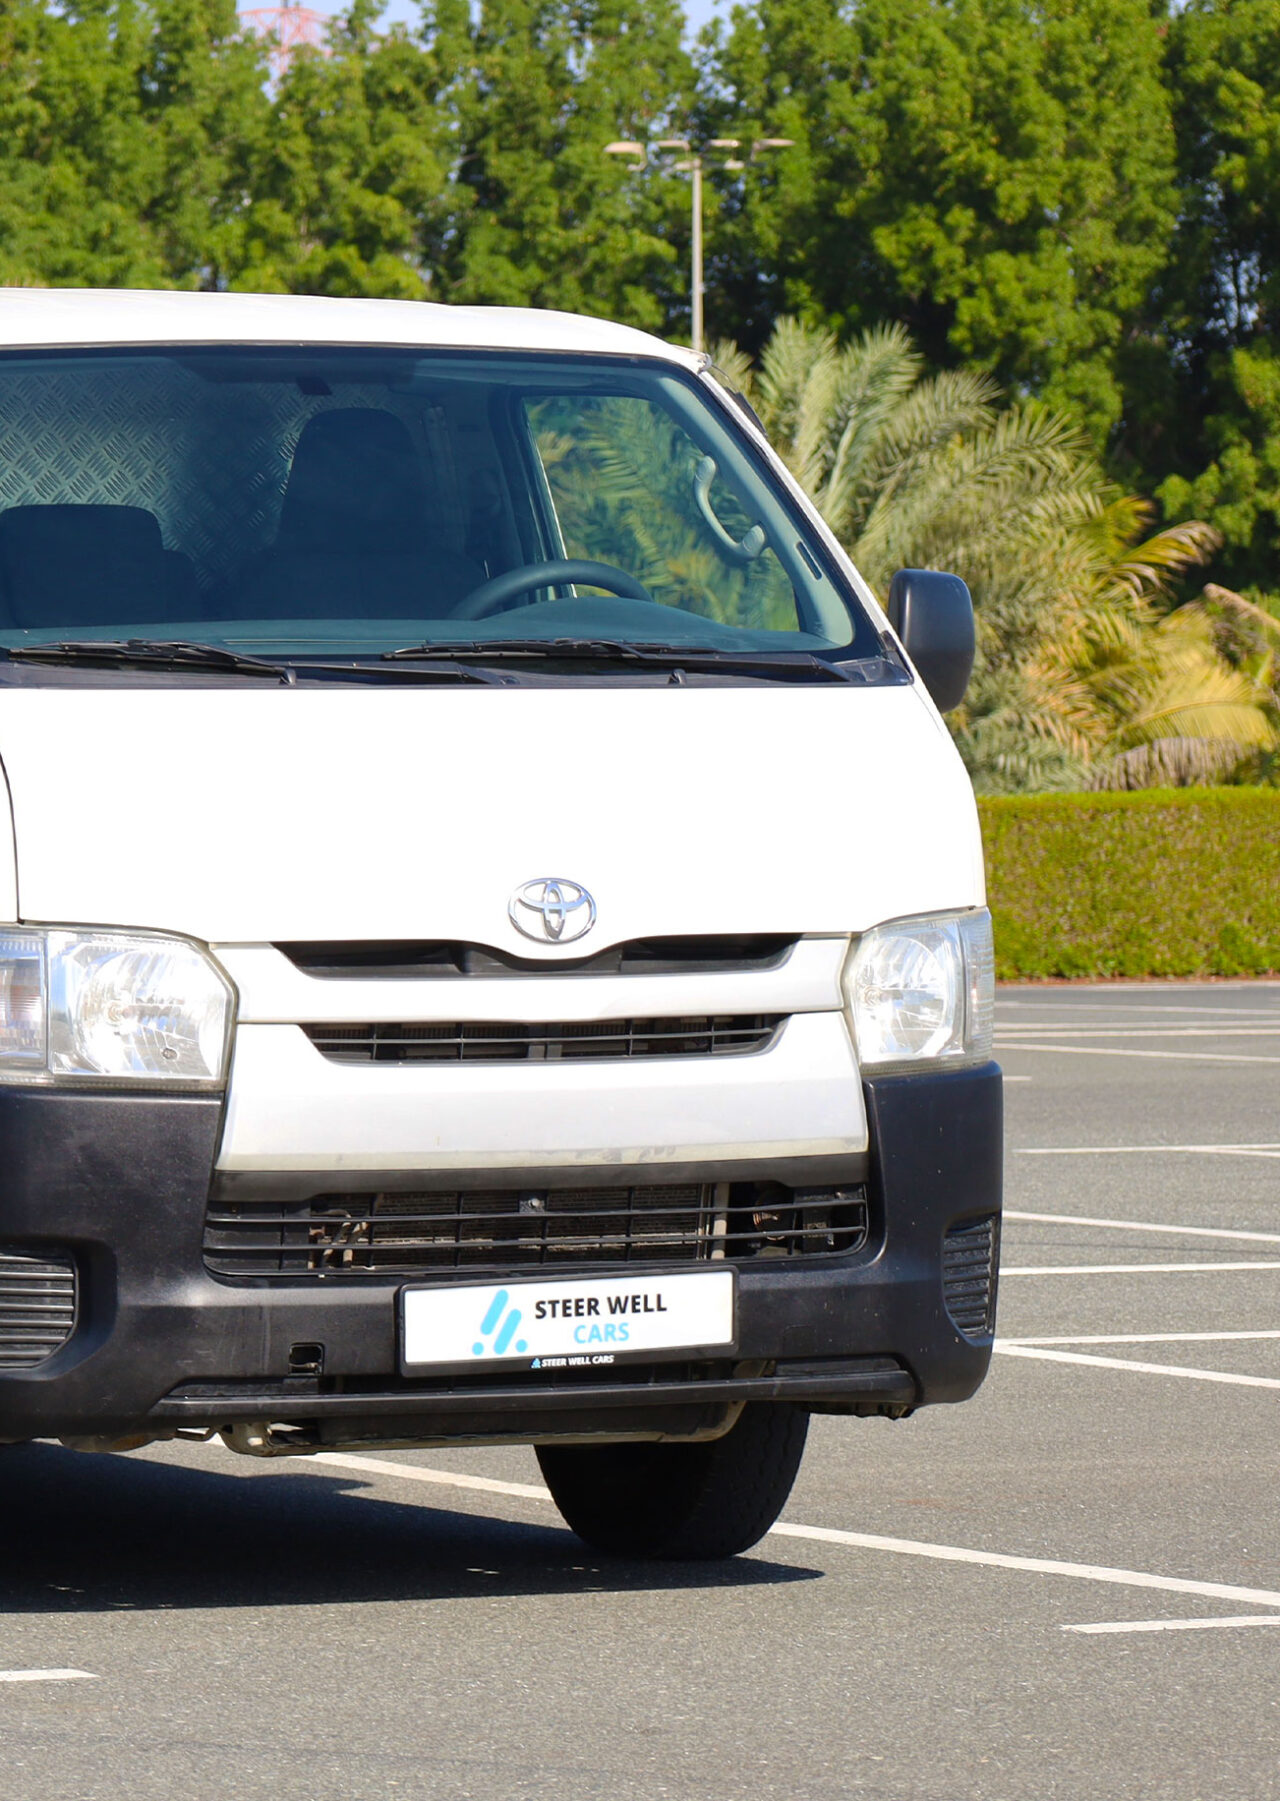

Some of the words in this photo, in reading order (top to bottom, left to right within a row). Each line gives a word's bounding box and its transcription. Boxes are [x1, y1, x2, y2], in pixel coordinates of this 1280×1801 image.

[535, 1297, 600, 1319] STEER
[607, 1293, 668, 1315] WELL
[573, 1321, 630, 1344] CARS
[542, 1357, 567, 1368] STEER
[568, 1356, 591, 1366] WELL
[592, 1355, 614, 1364] CARS
